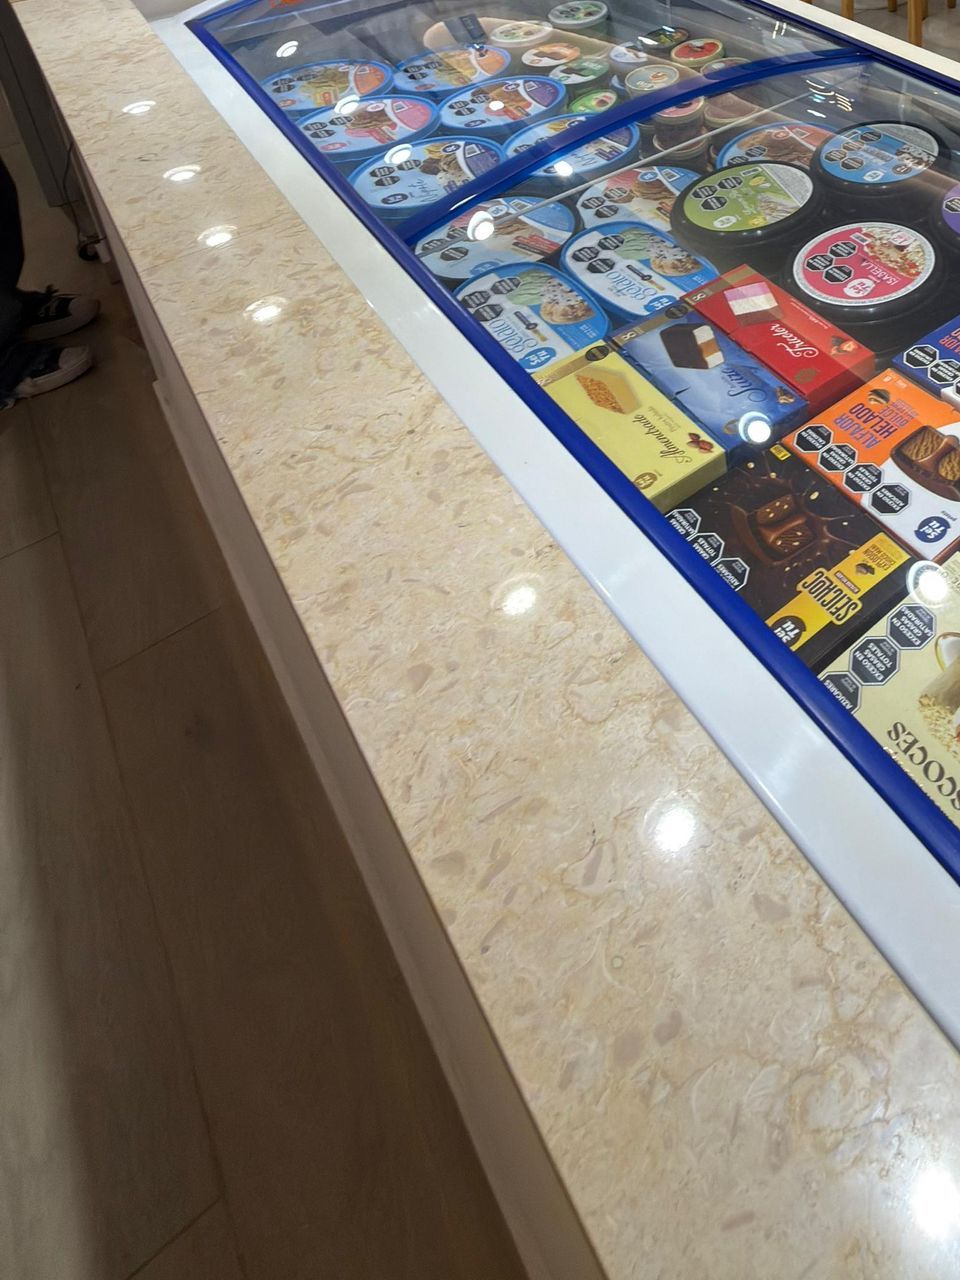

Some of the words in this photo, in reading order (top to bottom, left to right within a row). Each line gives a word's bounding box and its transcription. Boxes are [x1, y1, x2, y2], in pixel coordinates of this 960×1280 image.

[606, 268, 656, 303] gelato
[859, 259, 900, 287] ISABELLA
[769, 322, 817, 357] Tricolor
[721, 365, 767, 403] Suizo
[832, 413, 880, 448] ALFAJOR
[847, 401, 897, 439] HELADO
[630, 411, 692, 466] Almendrado
[668, 517, 686, 534] GRASAS
[692, 542, 710, 560] GRASAS
[696, 536, 717, 556] TOTALES
[800, 569, 858, 622] SEICHOC
[890, 616, 902, 627] EN
[898, 623, 921, 646] EXCESO
[899, 614, 923, 638] GRASAS
[900, 604, 932, 637] SATURADAS
[853, 649, 865, 661] EN
[862, 647, 886, 672] GRASAS
[867, 640, 893, 668] TOTALES
[860, 657, 884, 681] EXCESO
